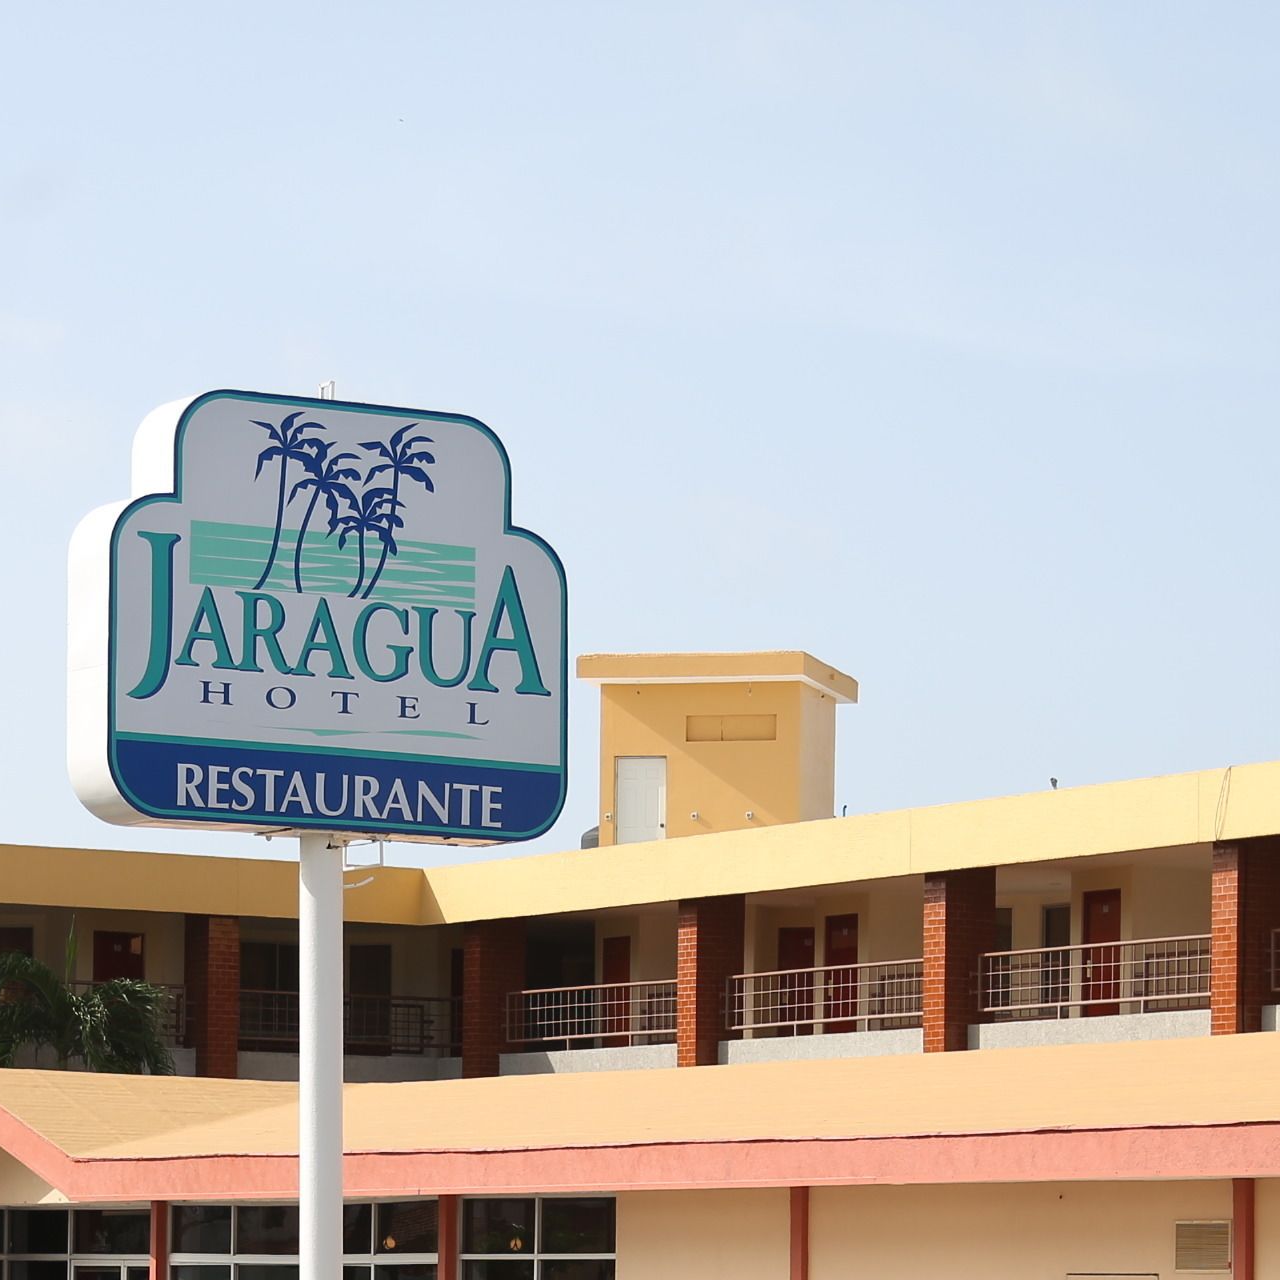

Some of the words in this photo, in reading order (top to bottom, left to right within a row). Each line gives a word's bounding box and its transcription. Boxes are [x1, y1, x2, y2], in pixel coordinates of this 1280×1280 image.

[126, 531, 551, 697] JARAGUA
[200, 680, 490, 725] HOTEL
[177, 763, 503, 828] RESTAURANTE
